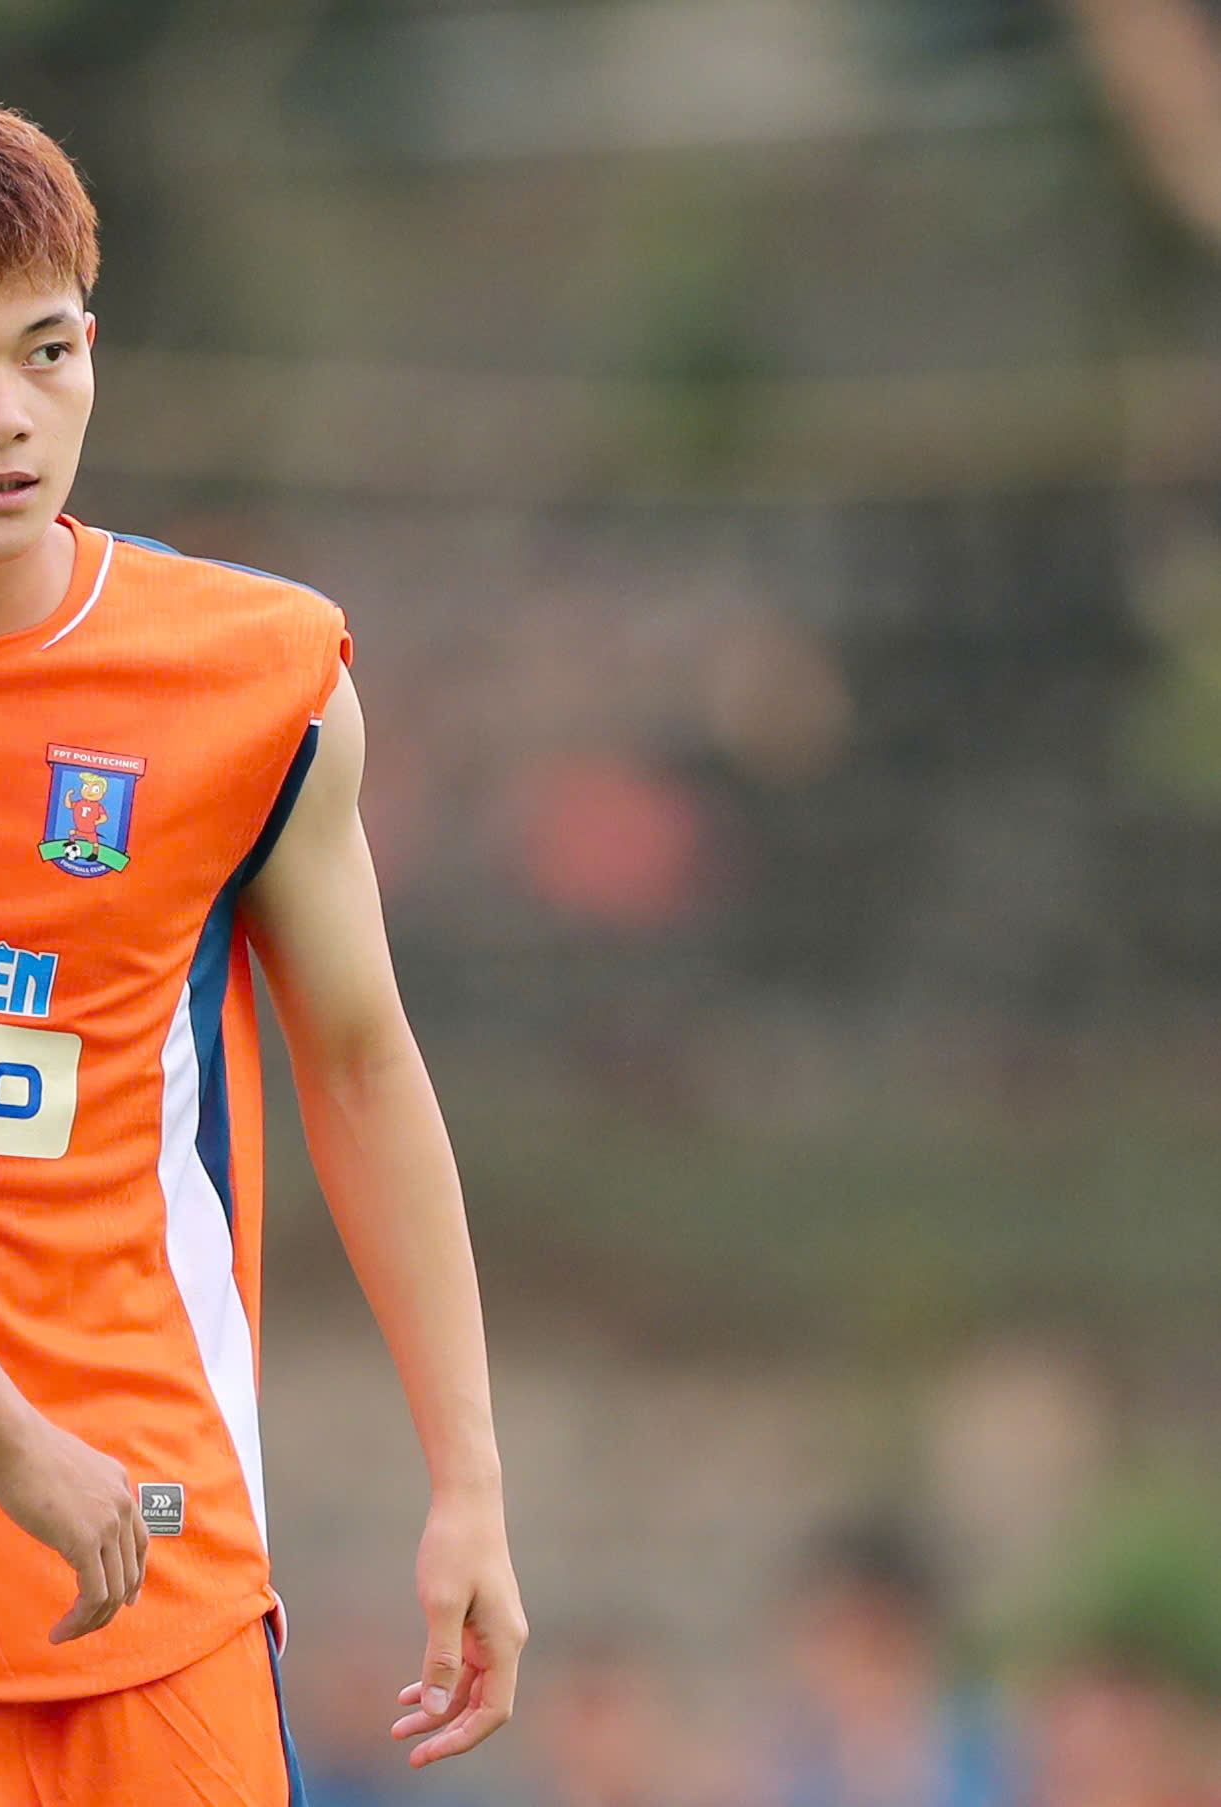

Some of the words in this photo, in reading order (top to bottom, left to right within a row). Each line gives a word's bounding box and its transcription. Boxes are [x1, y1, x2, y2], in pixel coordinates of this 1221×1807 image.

[53, 749, 72, 758] FPT
[73, 752, 139, 769] POLYTECHNIC
[81, 806, 92, 817] F
[59, 859, 89, 873] FOOTBALL
[89, 864, 107, 873] CLUB
